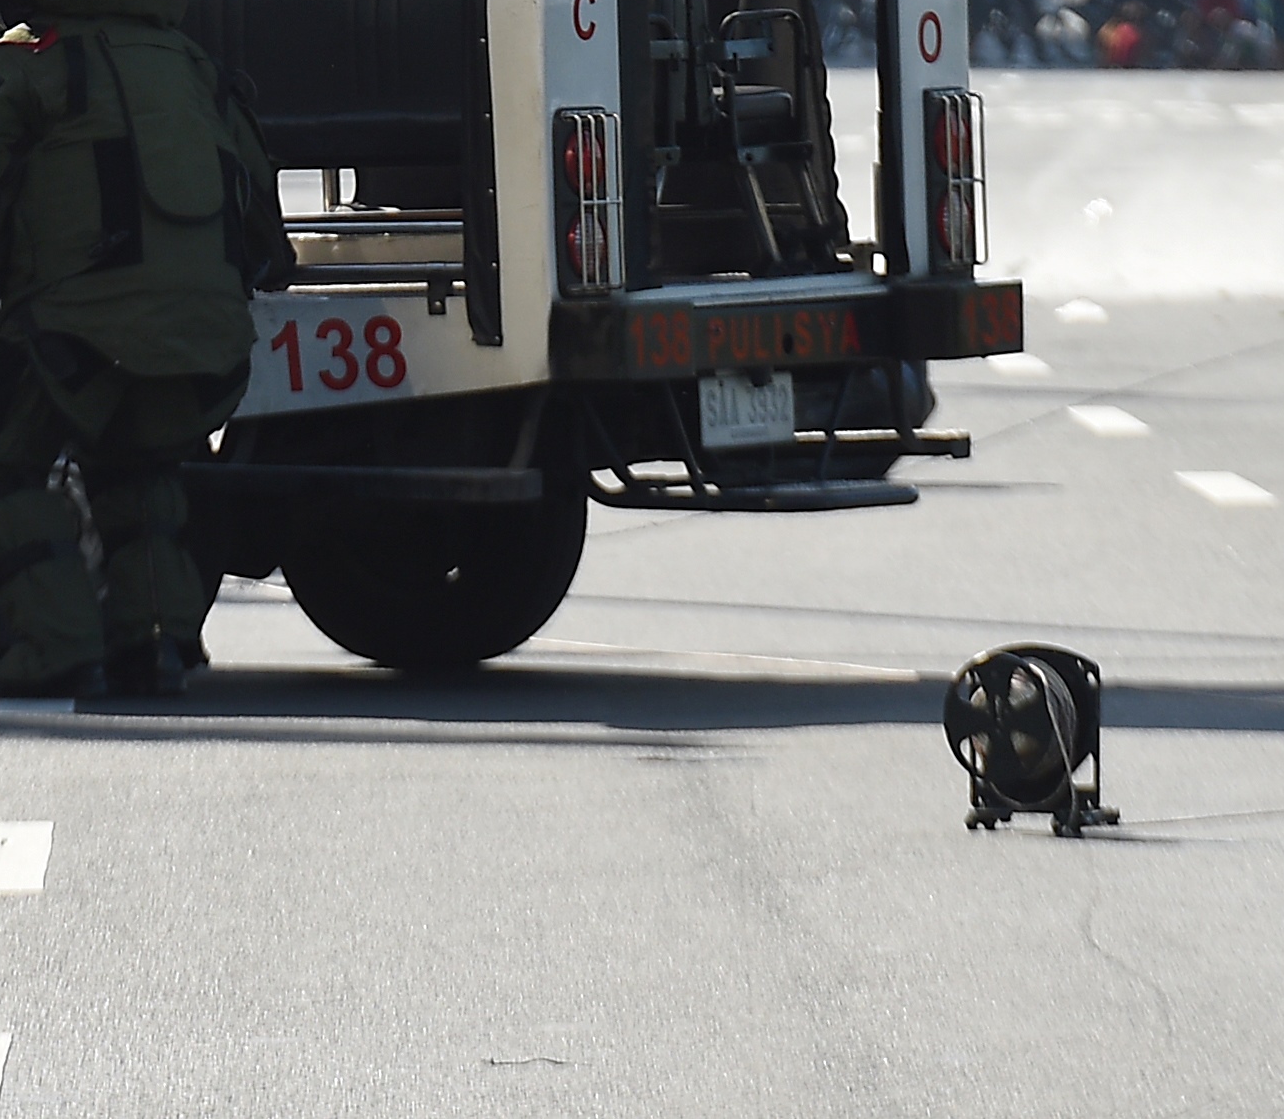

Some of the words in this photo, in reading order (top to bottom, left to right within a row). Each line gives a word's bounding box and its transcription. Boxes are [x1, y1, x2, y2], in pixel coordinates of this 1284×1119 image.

[629, 310, 692, 368] 138
[707, 308, 863, 363] PULISYA
[961, 288, 1021, 350] 138
[270, 315, 409, 392] 138
